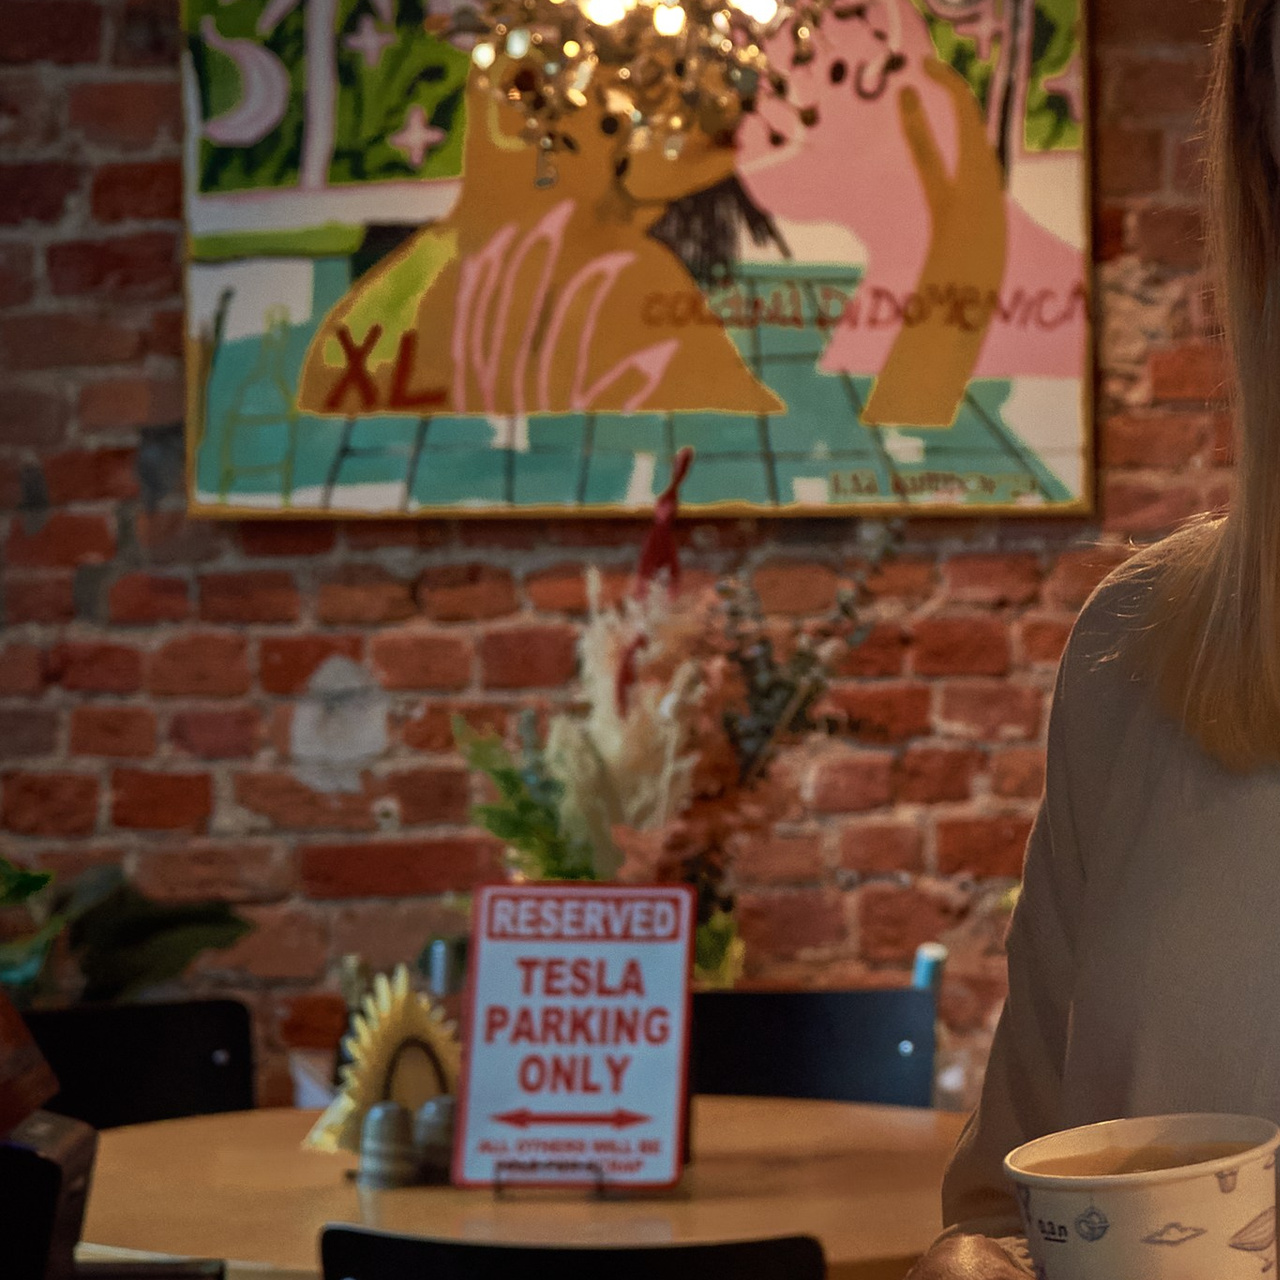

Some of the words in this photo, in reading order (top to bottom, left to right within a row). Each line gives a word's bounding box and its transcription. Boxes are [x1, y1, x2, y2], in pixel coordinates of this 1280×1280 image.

[326, 323, 448, 410] XL
[491, 898, 677, 936] RESERVED
[517, 956, 645, 998] TESLA
[484, 1005, 672, 1046] PARKING
[518, 1053, 631, 1095] ONLY
